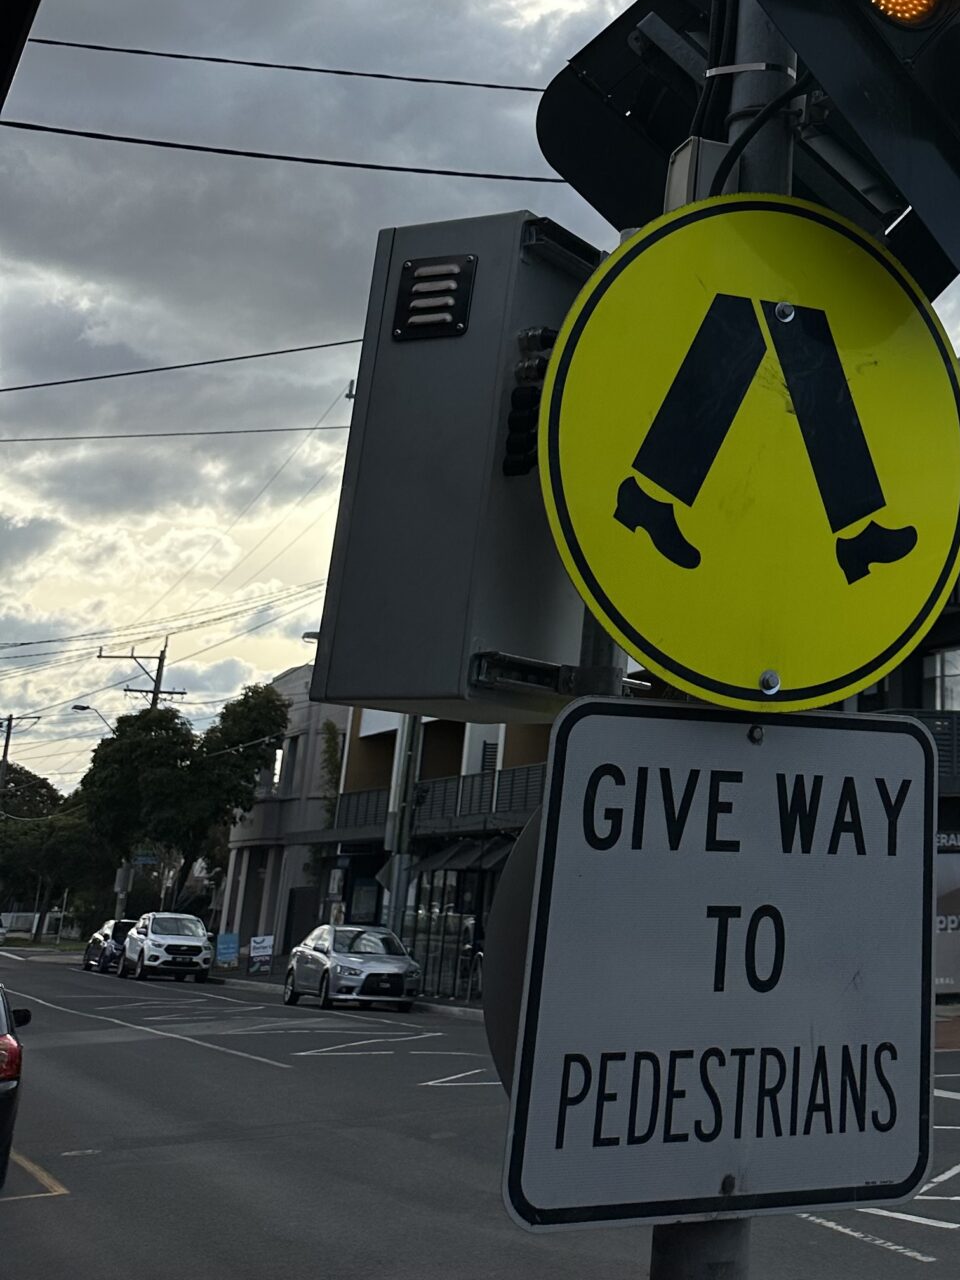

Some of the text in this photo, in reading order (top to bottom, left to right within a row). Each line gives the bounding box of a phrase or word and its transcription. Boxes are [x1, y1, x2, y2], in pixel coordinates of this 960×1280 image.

[582, 763, 912, 857] GIVE WAY
[706, 904, 786, 993] TO
[554, 1041, 898, 1150] PEDESTRIANS
